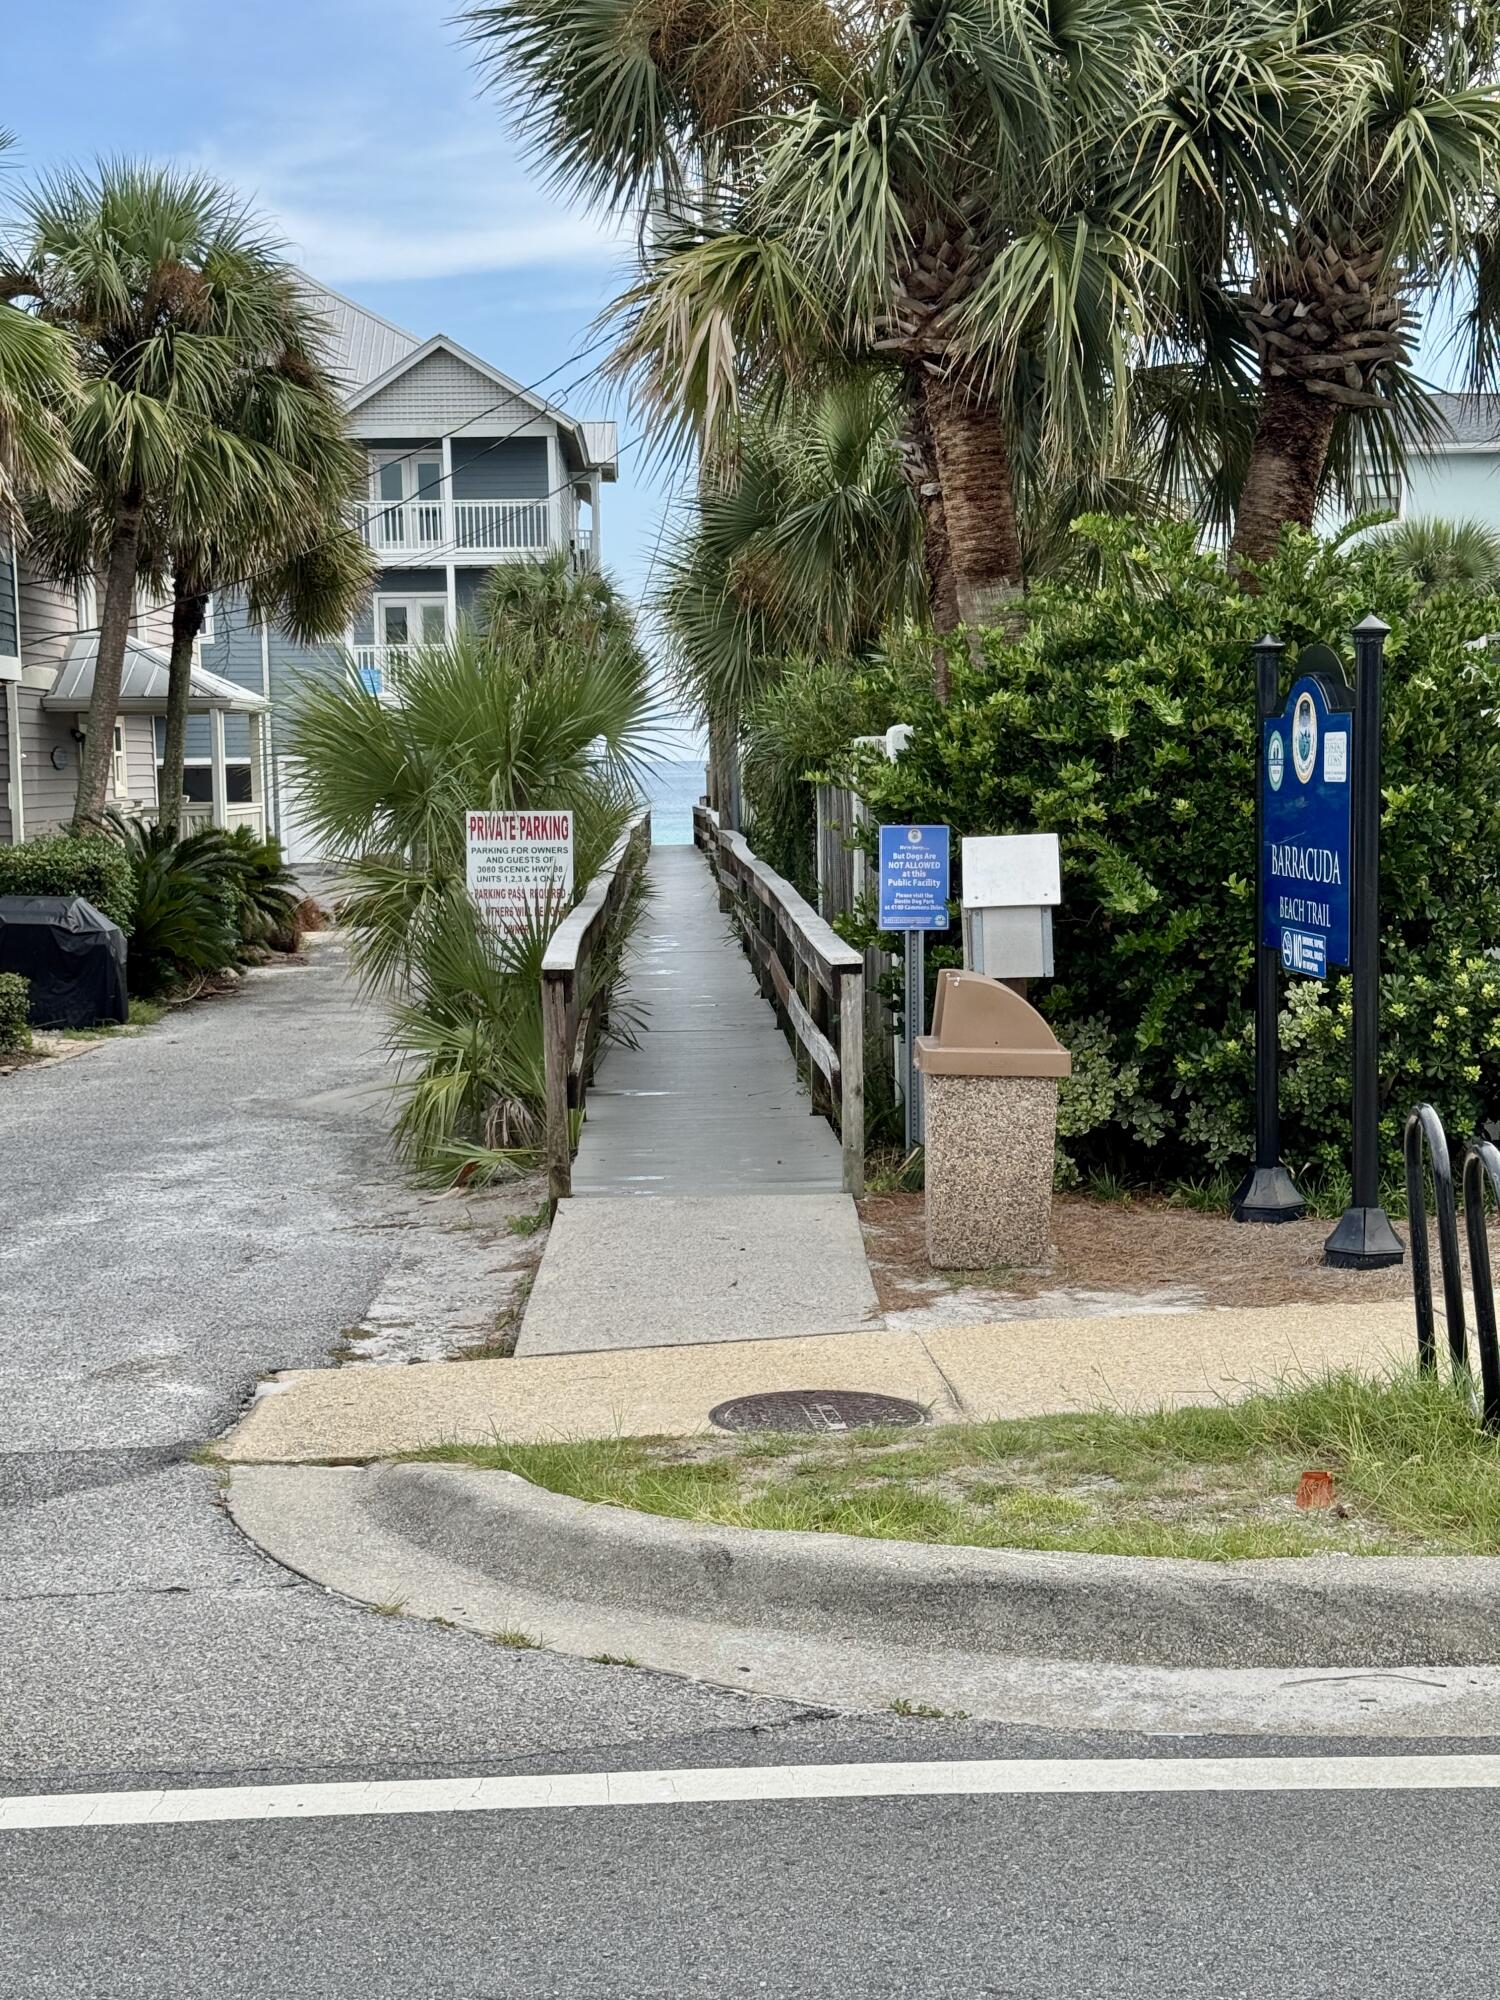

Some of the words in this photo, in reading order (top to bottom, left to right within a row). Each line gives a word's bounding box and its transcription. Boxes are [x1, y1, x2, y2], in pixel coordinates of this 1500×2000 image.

[470, 816, 516, 840] PRIVATE
[520, 815, 568, 840] PARKING
[906, 853, 923, 861] Dogs
[888, 861, 904, 869] NOT
[905, 861, 941, 869] ALLOWED
[1271, 844, 1341, 885] BARRACUDA
[888, 879, 912, 887] Public
[913, 879, 941, 889] Facility
[475, 889, 506, 899] PARKING
[508, 889, 526, 900] PASS
[1279, 896, 1305, 922] BEACH
[1306, 901, 1331, 928] TRAIL
